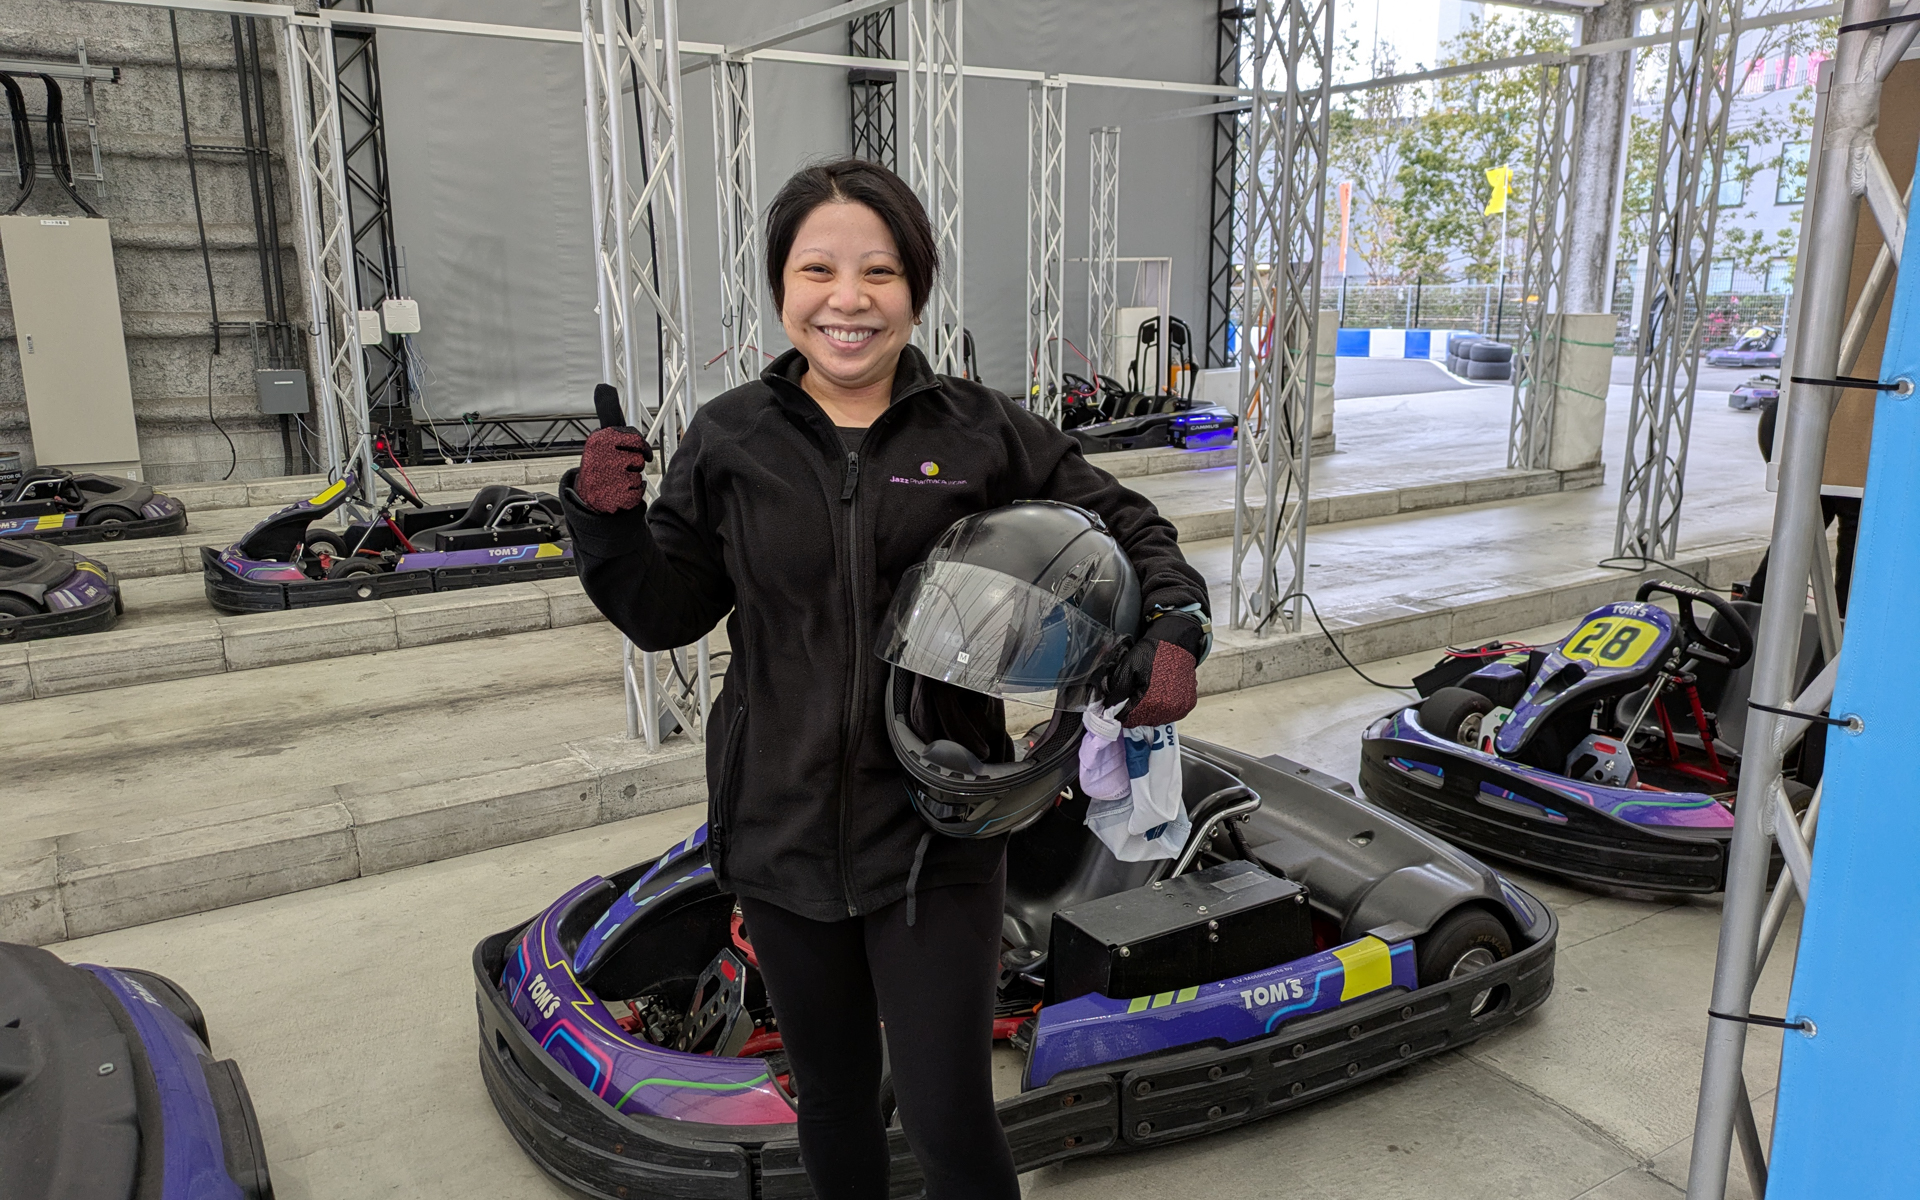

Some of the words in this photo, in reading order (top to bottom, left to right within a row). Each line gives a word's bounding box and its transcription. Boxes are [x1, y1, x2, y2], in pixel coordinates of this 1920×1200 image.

[1190, 423, 1219, 431] CAMMUS
[889, 475, 909, 485] Jazz
[489, 547, 518, 557] TOM'S
[1571, 622, 1641, 661] 28
[960, 653, 967, 662] M
[528, 973, 561, 1019] TOM'S
[1240, 979, 1304, 1009] TOM'S
